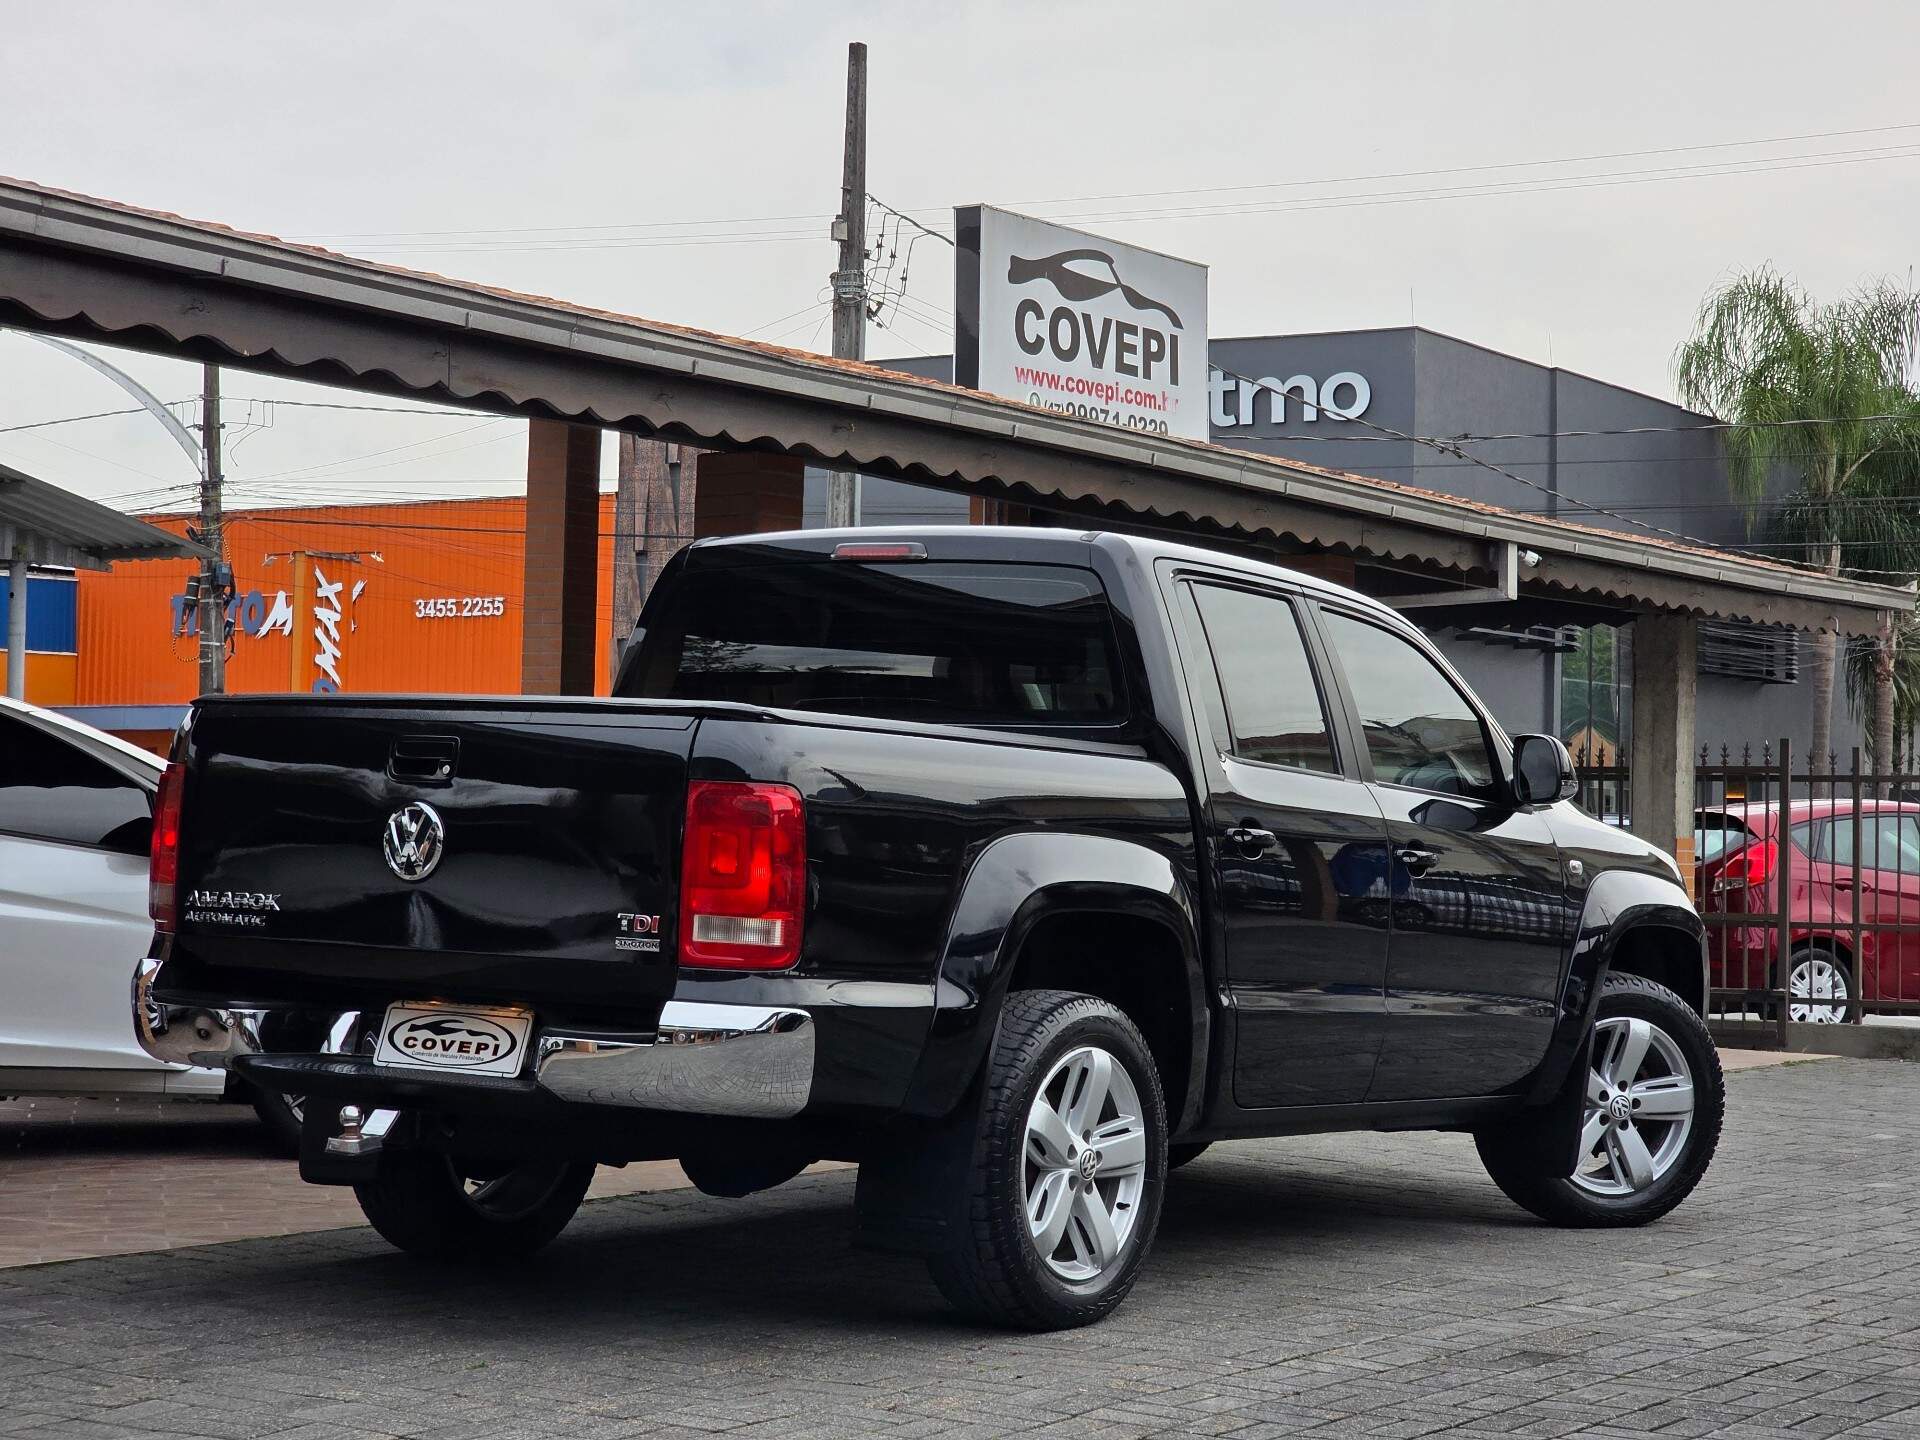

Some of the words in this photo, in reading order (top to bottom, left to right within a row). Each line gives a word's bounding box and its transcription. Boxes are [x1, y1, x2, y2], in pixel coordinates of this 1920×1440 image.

[1014, 298, 1179, 386] COVEPI
[1208, 371, 1371, 427] tmo
[415, 597, 504, 618] 3455.2255
[184, 890, 280, 911] AMAROK
[617, 913, 660, 933] TDI
[403, 1036, 500, 1057] COVEPI
